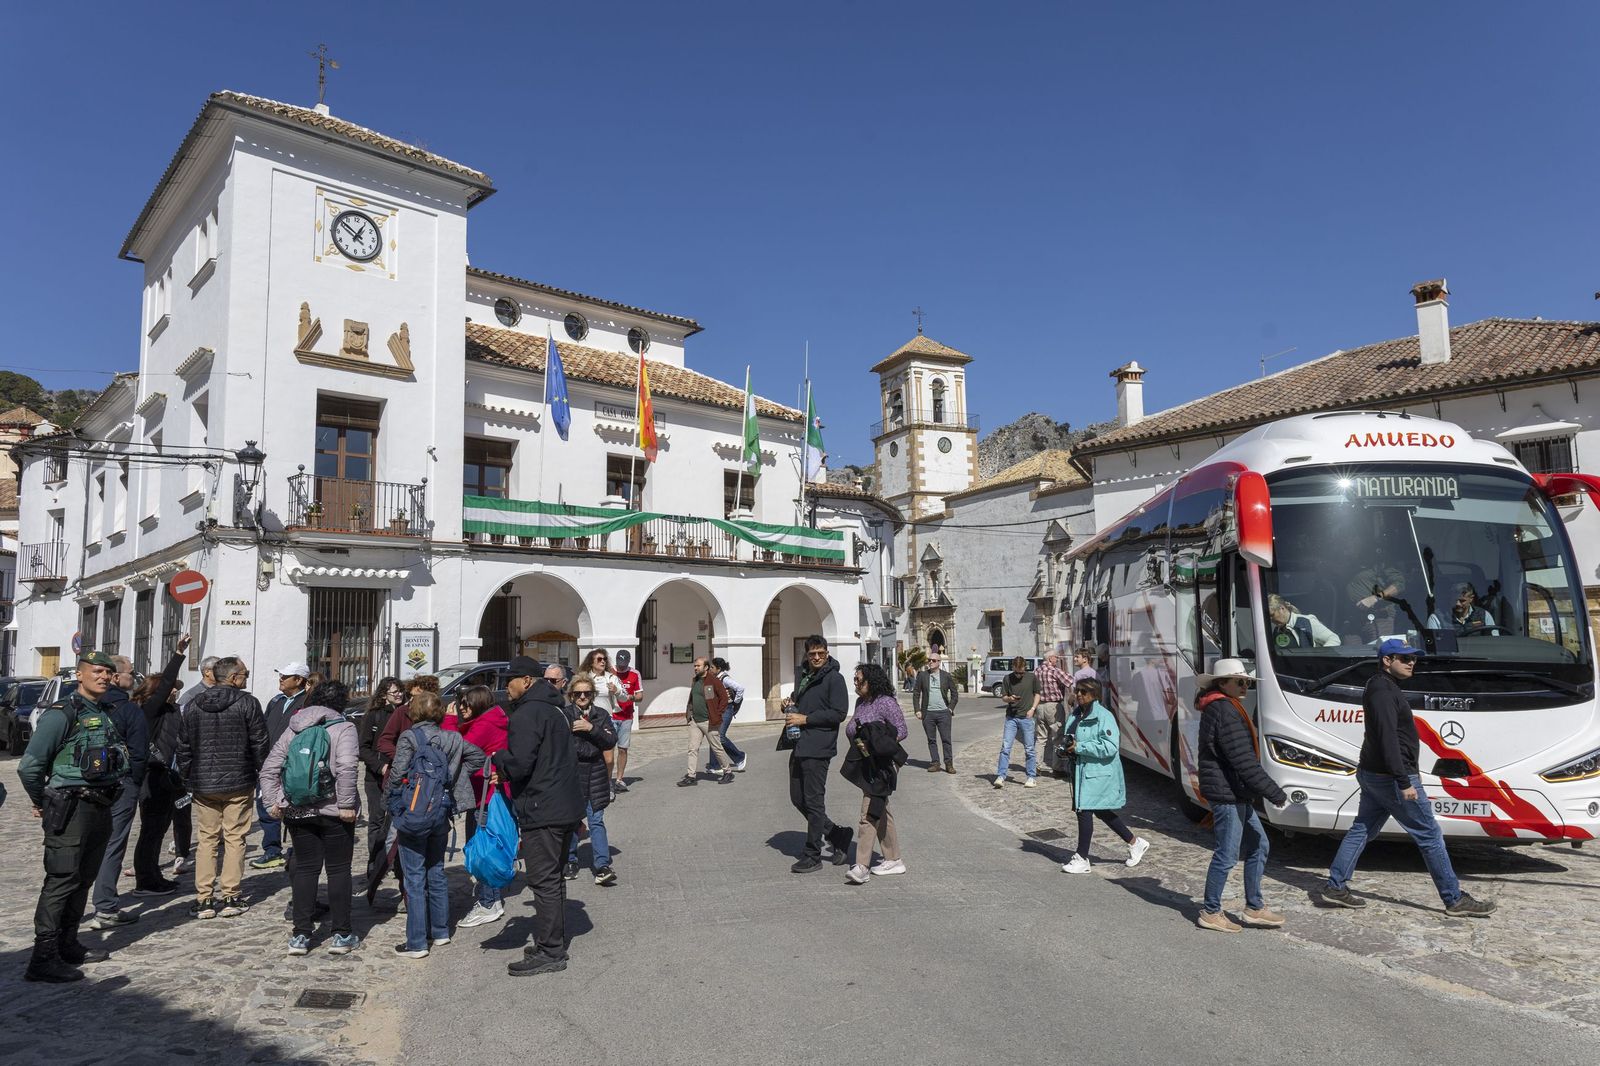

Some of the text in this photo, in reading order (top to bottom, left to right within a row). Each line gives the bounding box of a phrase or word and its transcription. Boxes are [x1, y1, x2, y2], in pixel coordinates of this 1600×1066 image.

[602, 406, 616, 418] CASA
[1344, 432, 1455, 448] AMUEDO
[1356, 476, 1459, 497] NATURANDA
[1314, 709, 1364, 723] AMUE
[1430, 801, 1488, 815] 957 NFT
